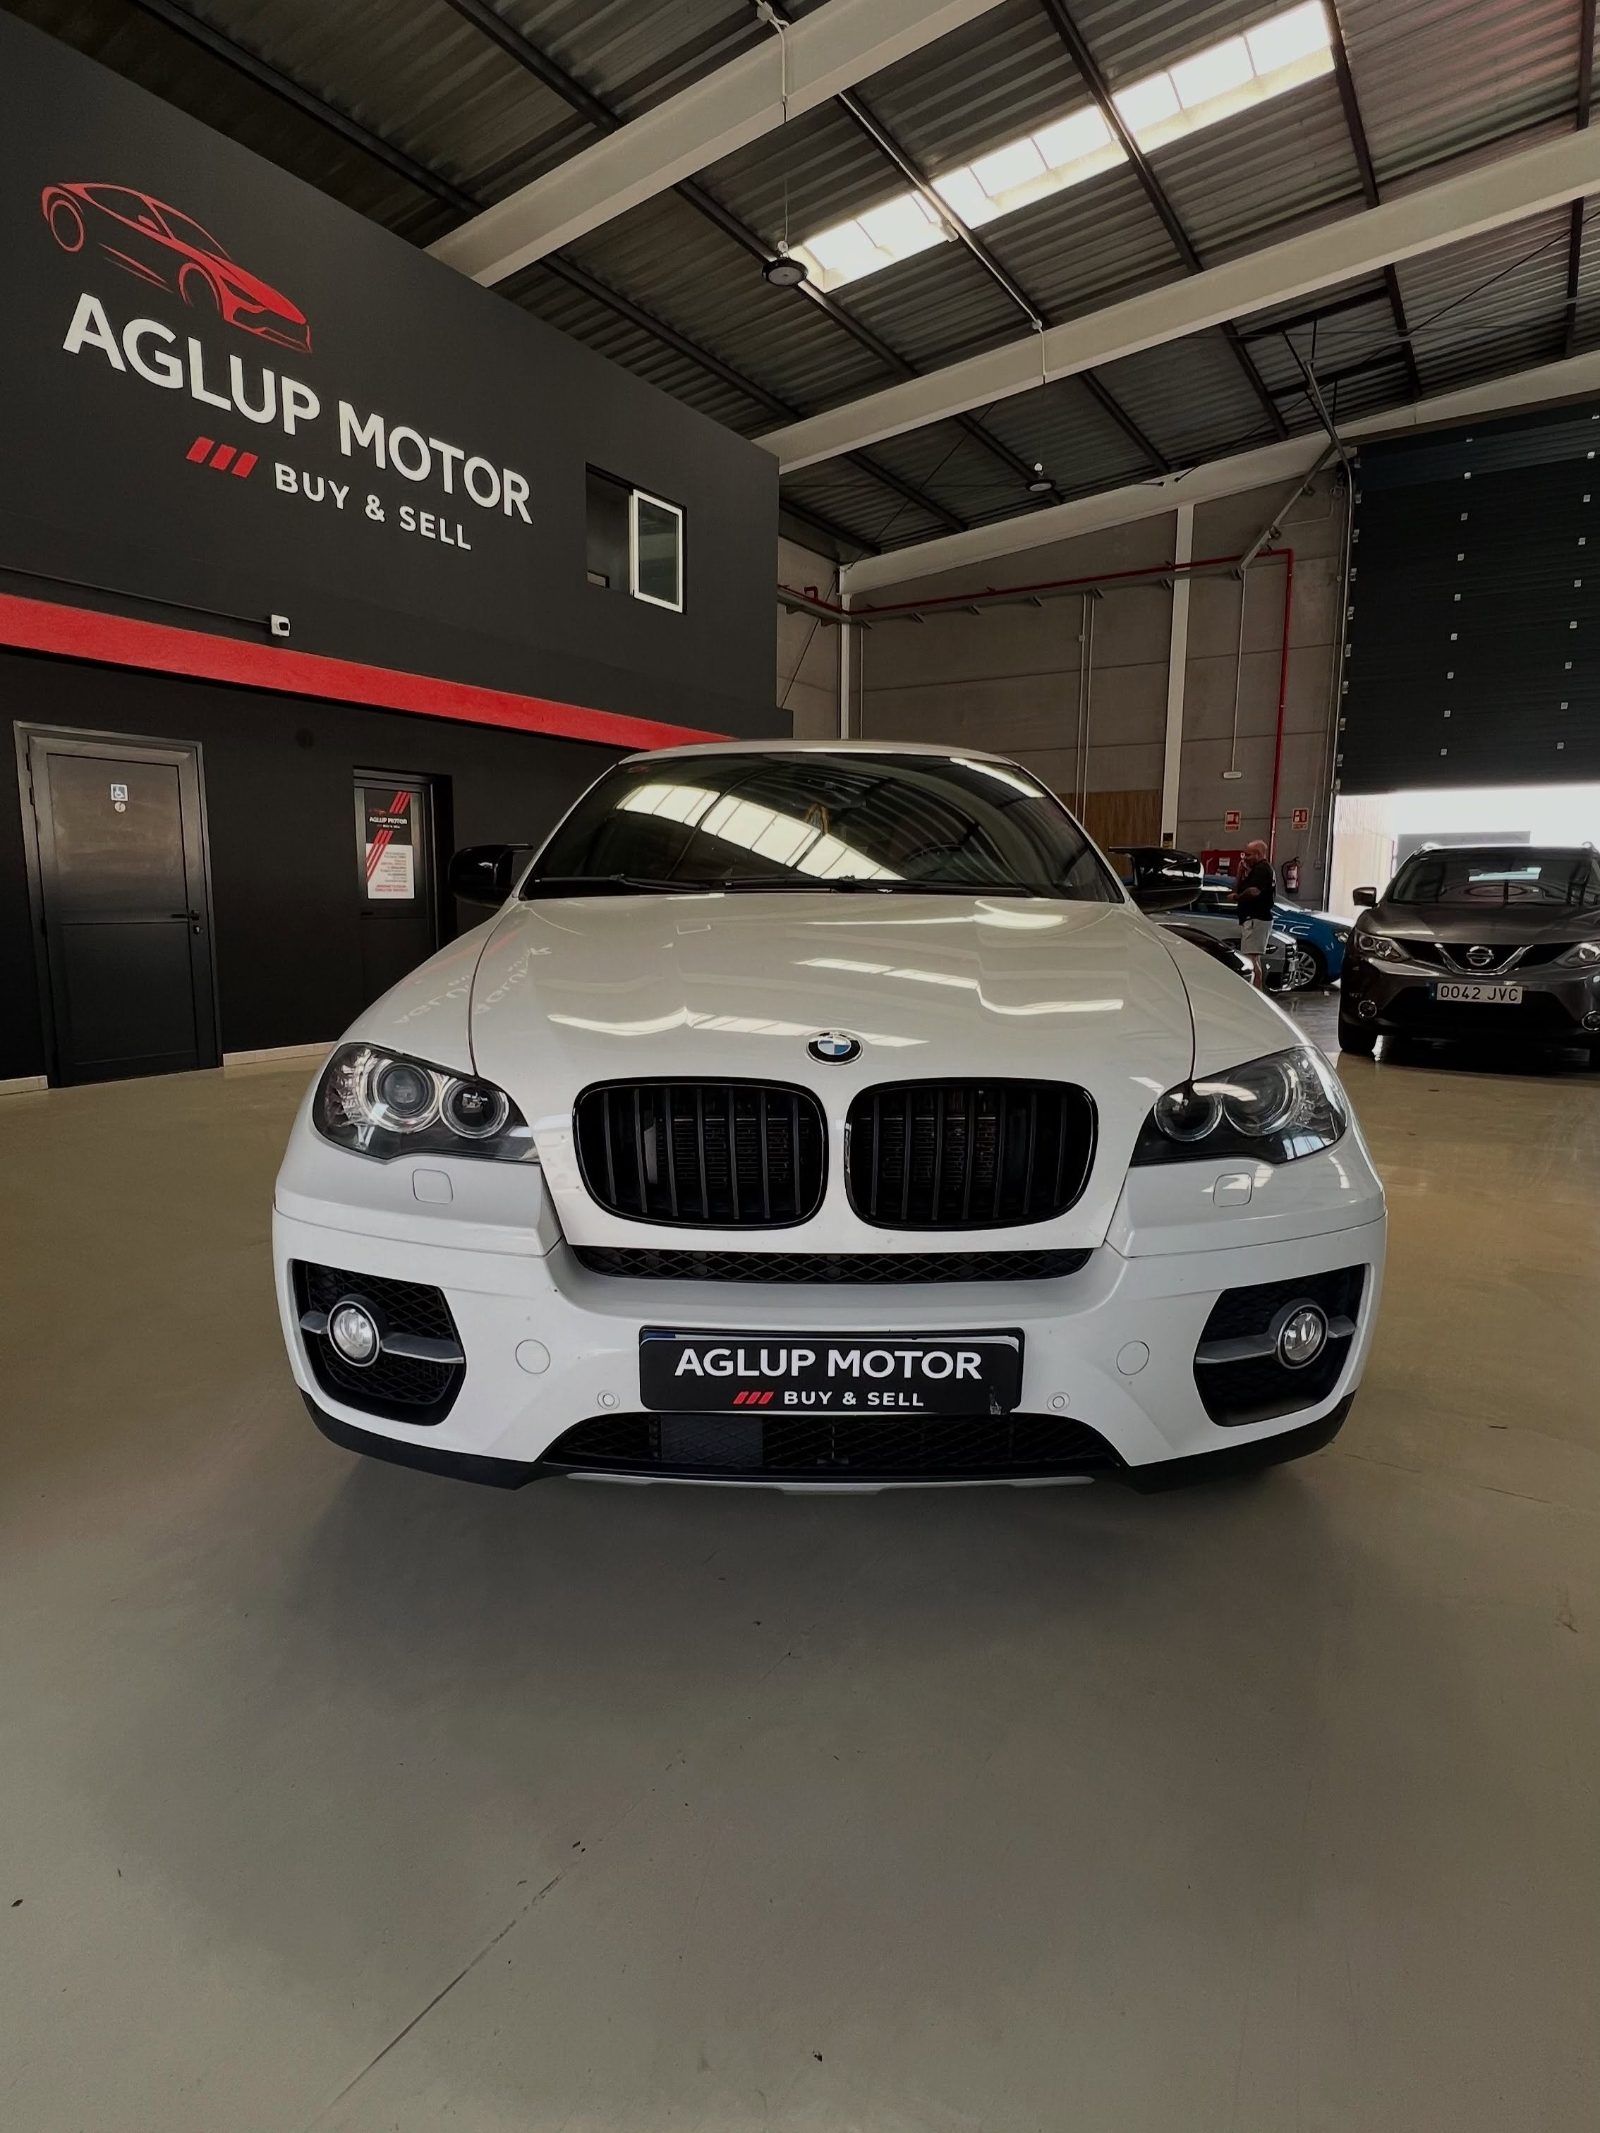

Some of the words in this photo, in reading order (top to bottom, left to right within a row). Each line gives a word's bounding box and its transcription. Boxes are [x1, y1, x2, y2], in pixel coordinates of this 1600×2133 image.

[62, 292, 321, 436] AGLUP
[338, 400, 534, 525] MOTOR
[274, 462, 350, 510] BUY
[364, 494, 387, 523] &
[399, 505, 472, 551] SELL
[1440, 985, 1481, 1000] 0042
[1487, 987, 1519, 1001] JVC
[674, 1348, 816, 1377] AGLUP
[827, 1349, 983, 1380] MOTOR
[783, 1390, 833, 1405] BUY
[842, 1391, 857, 1406] &
[867, 1391, 924, 1407] SELL
